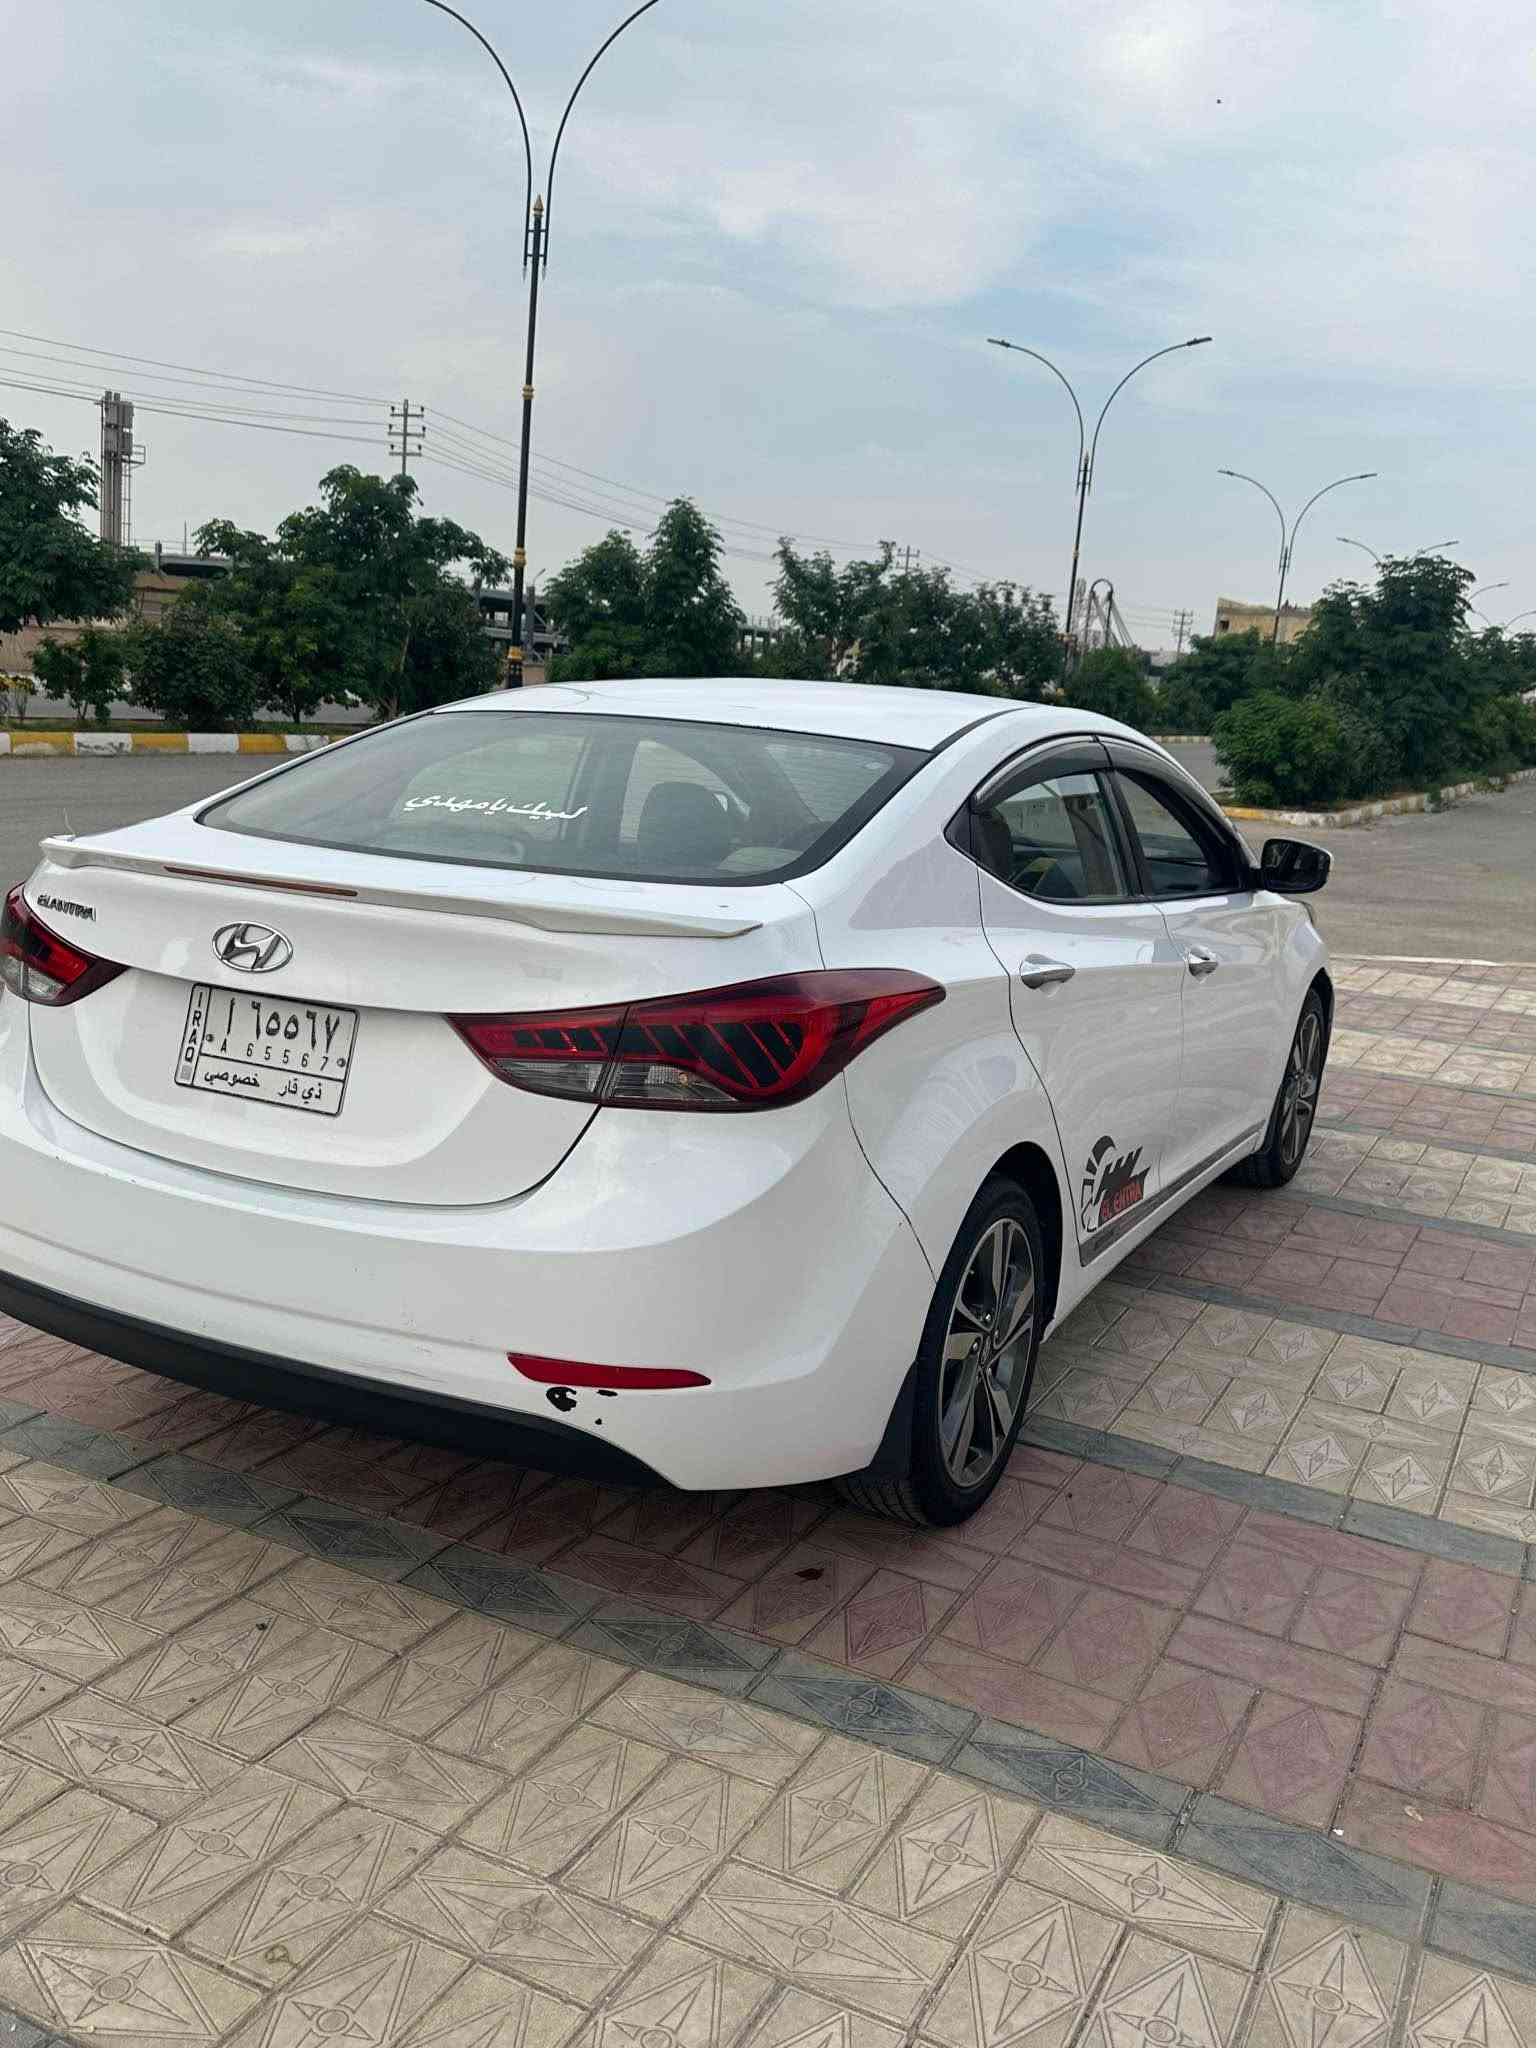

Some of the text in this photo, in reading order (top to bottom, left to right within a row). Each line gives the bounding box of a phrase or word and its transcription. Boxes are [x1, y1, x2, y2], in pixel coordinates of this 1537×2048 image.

[37, 894, 96, 921] ELANTRA
[183, 991, 203, 1063] IRAQ
[251, 1000, 341, 1054] ٦٥٥٦٧
[220, 1038, 329, 1071] A 65567
[204, 1069, 322, 1104] ذي قار خصوصي
